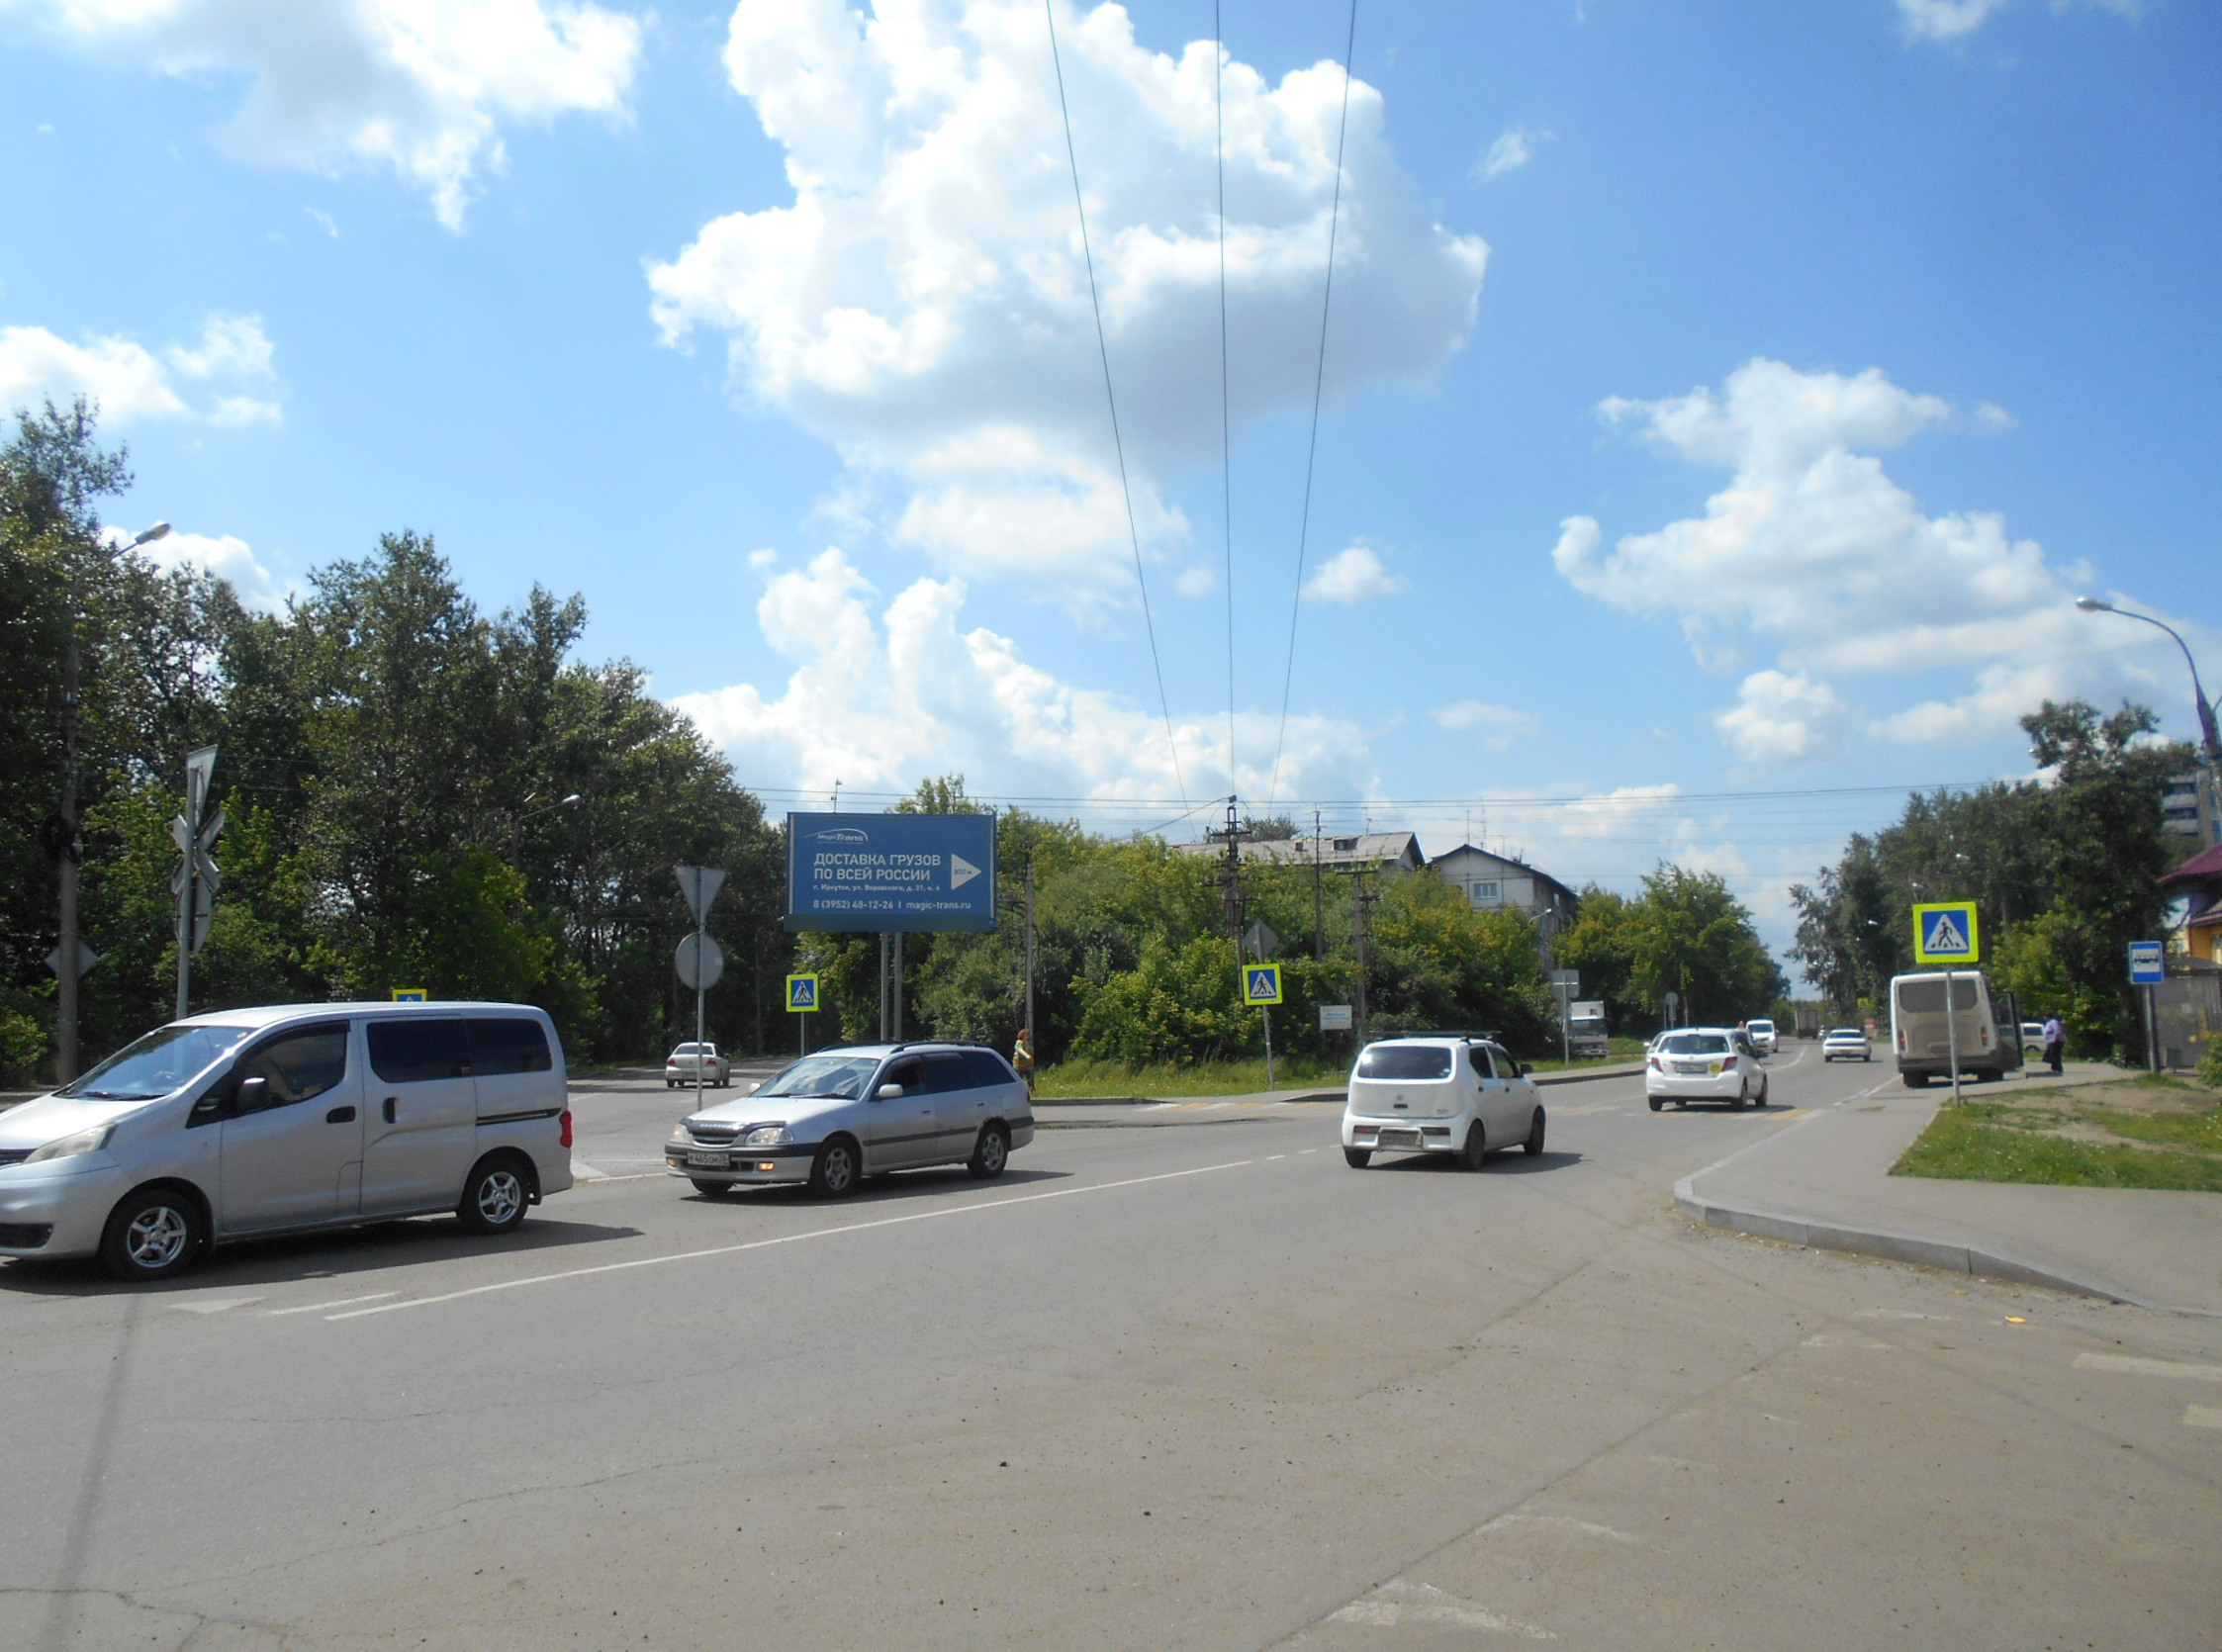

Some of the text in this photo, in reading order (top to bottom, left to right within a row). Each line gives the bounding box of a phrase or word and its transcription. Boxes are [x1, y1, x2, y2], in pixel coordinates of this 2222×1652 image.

[814, 854, 942, 867] ДОСТАВКА ГРУЗОВ
[814, 867, 931, 881] ПО ВСЕЙ РОССИИ
[813, 899, 972, 911] 8 (3952) 48-12-26 magic-trans.ru
